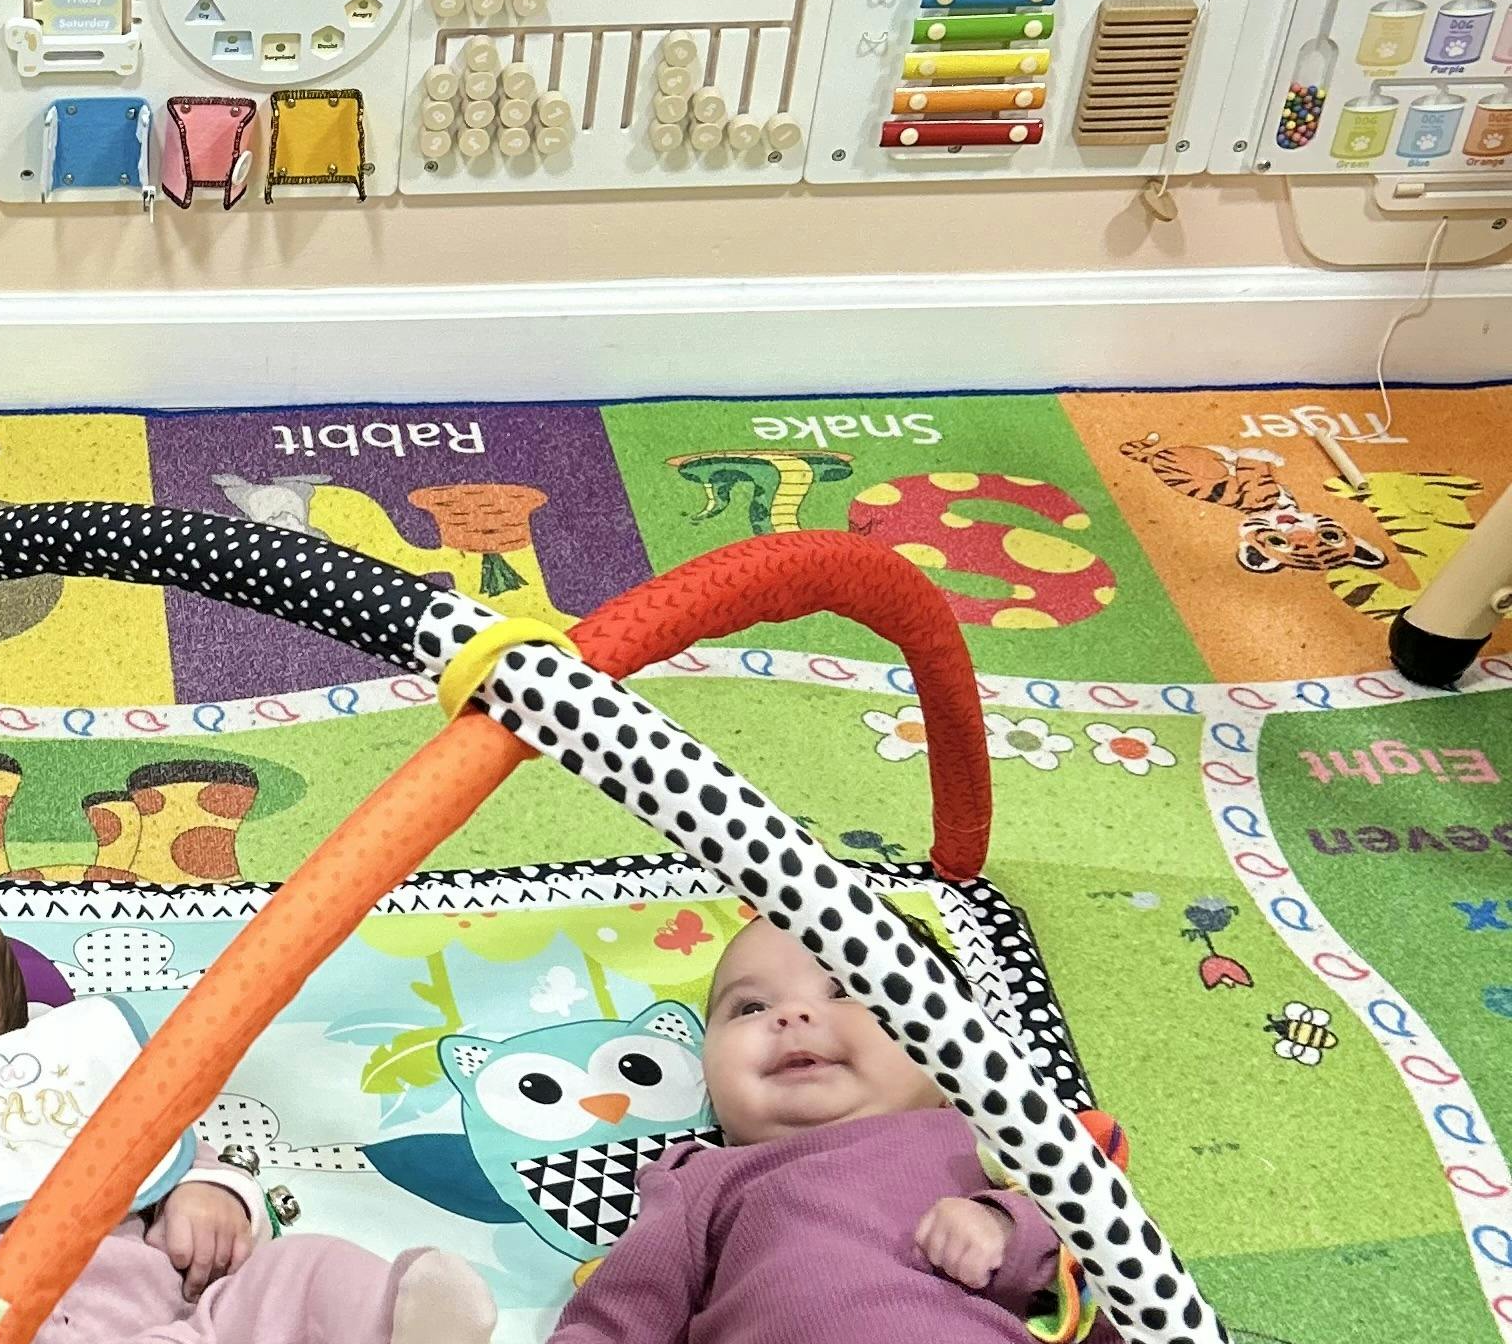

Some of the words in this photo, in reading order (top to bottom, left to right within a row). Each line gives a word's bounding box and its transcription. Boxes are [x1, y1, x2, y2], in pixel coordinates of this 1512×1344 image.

[59, 18, 111, 30] Saturday
[1449, 19, 1475, 30] DOG
[1430, 65, 1465, 75] Purple
[1466, 158, 1505, 168] Orange
[753, 413, 942, 446] Snake
[1239, 404, 1409, 444] Tiger
[273, 420, 486, 456] Rabbit
[1297, 739, 1501, 785] Eight
